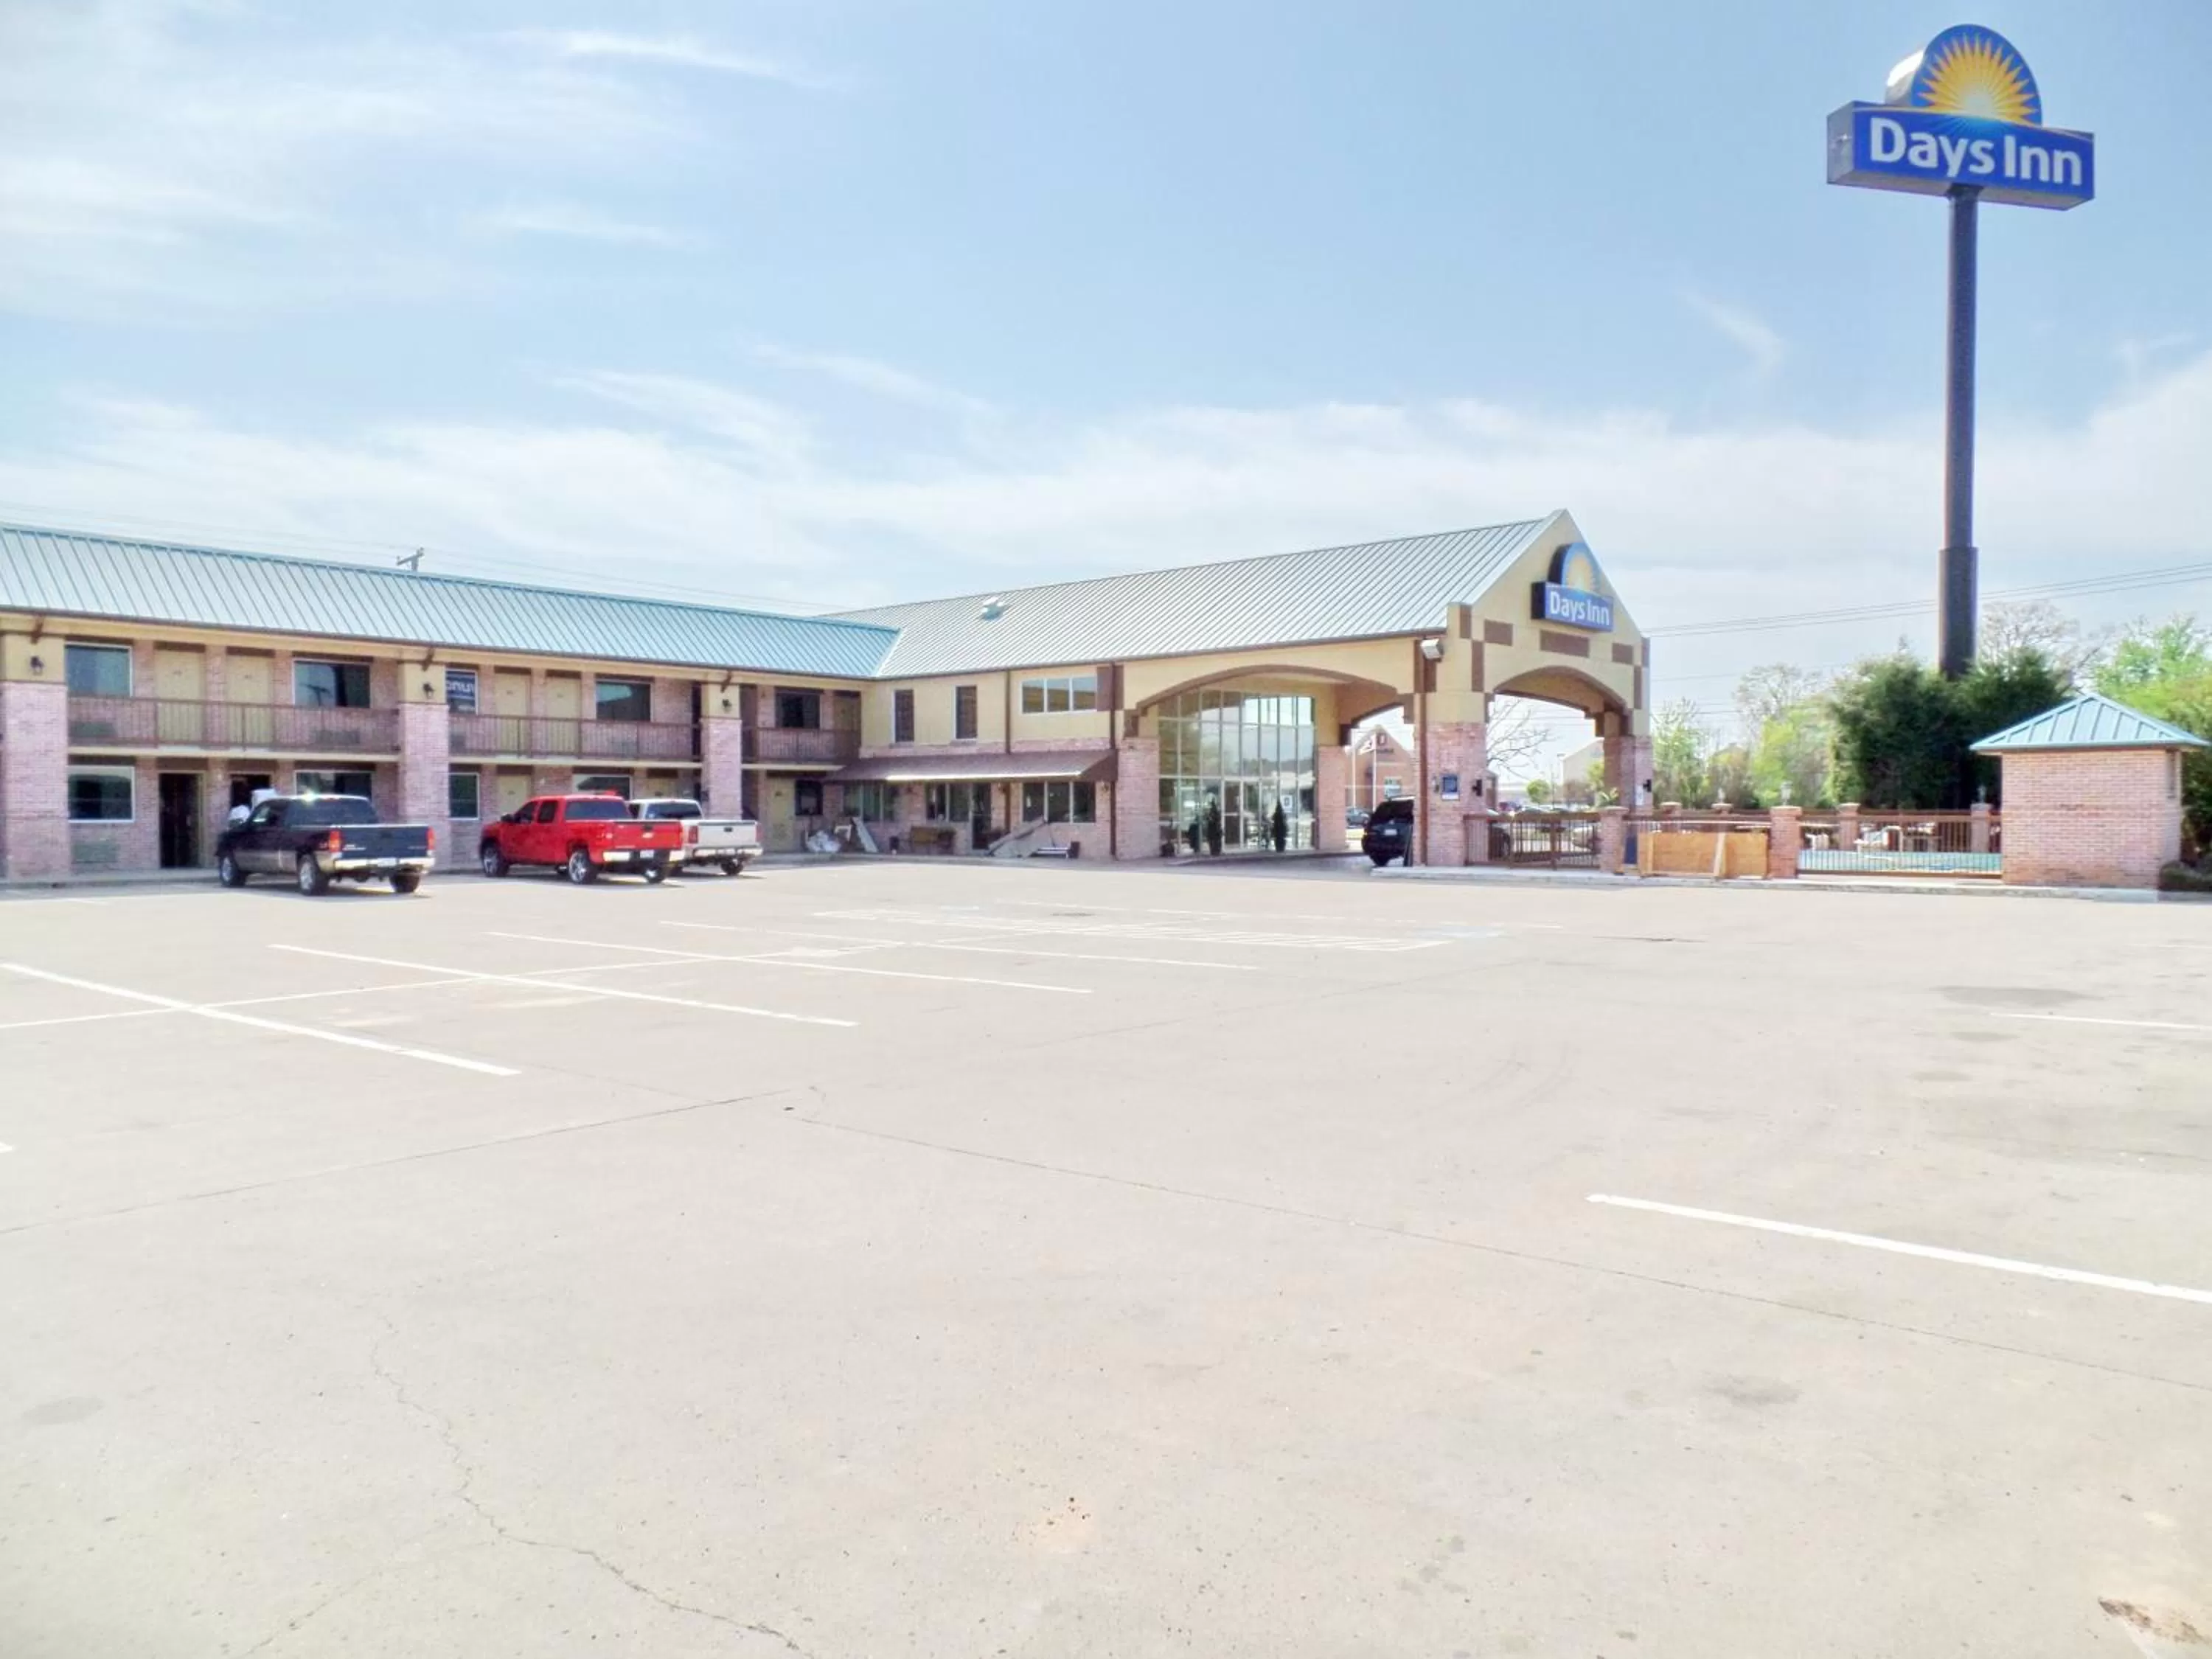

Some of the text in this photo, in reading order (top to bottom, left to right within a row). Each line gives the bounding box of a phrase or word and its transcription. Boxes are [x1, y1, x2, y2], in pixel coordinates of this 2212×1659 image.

[1871, 117, 2082, 185] Days Inn
[1551, 591, 1610, 625] Days Inn
